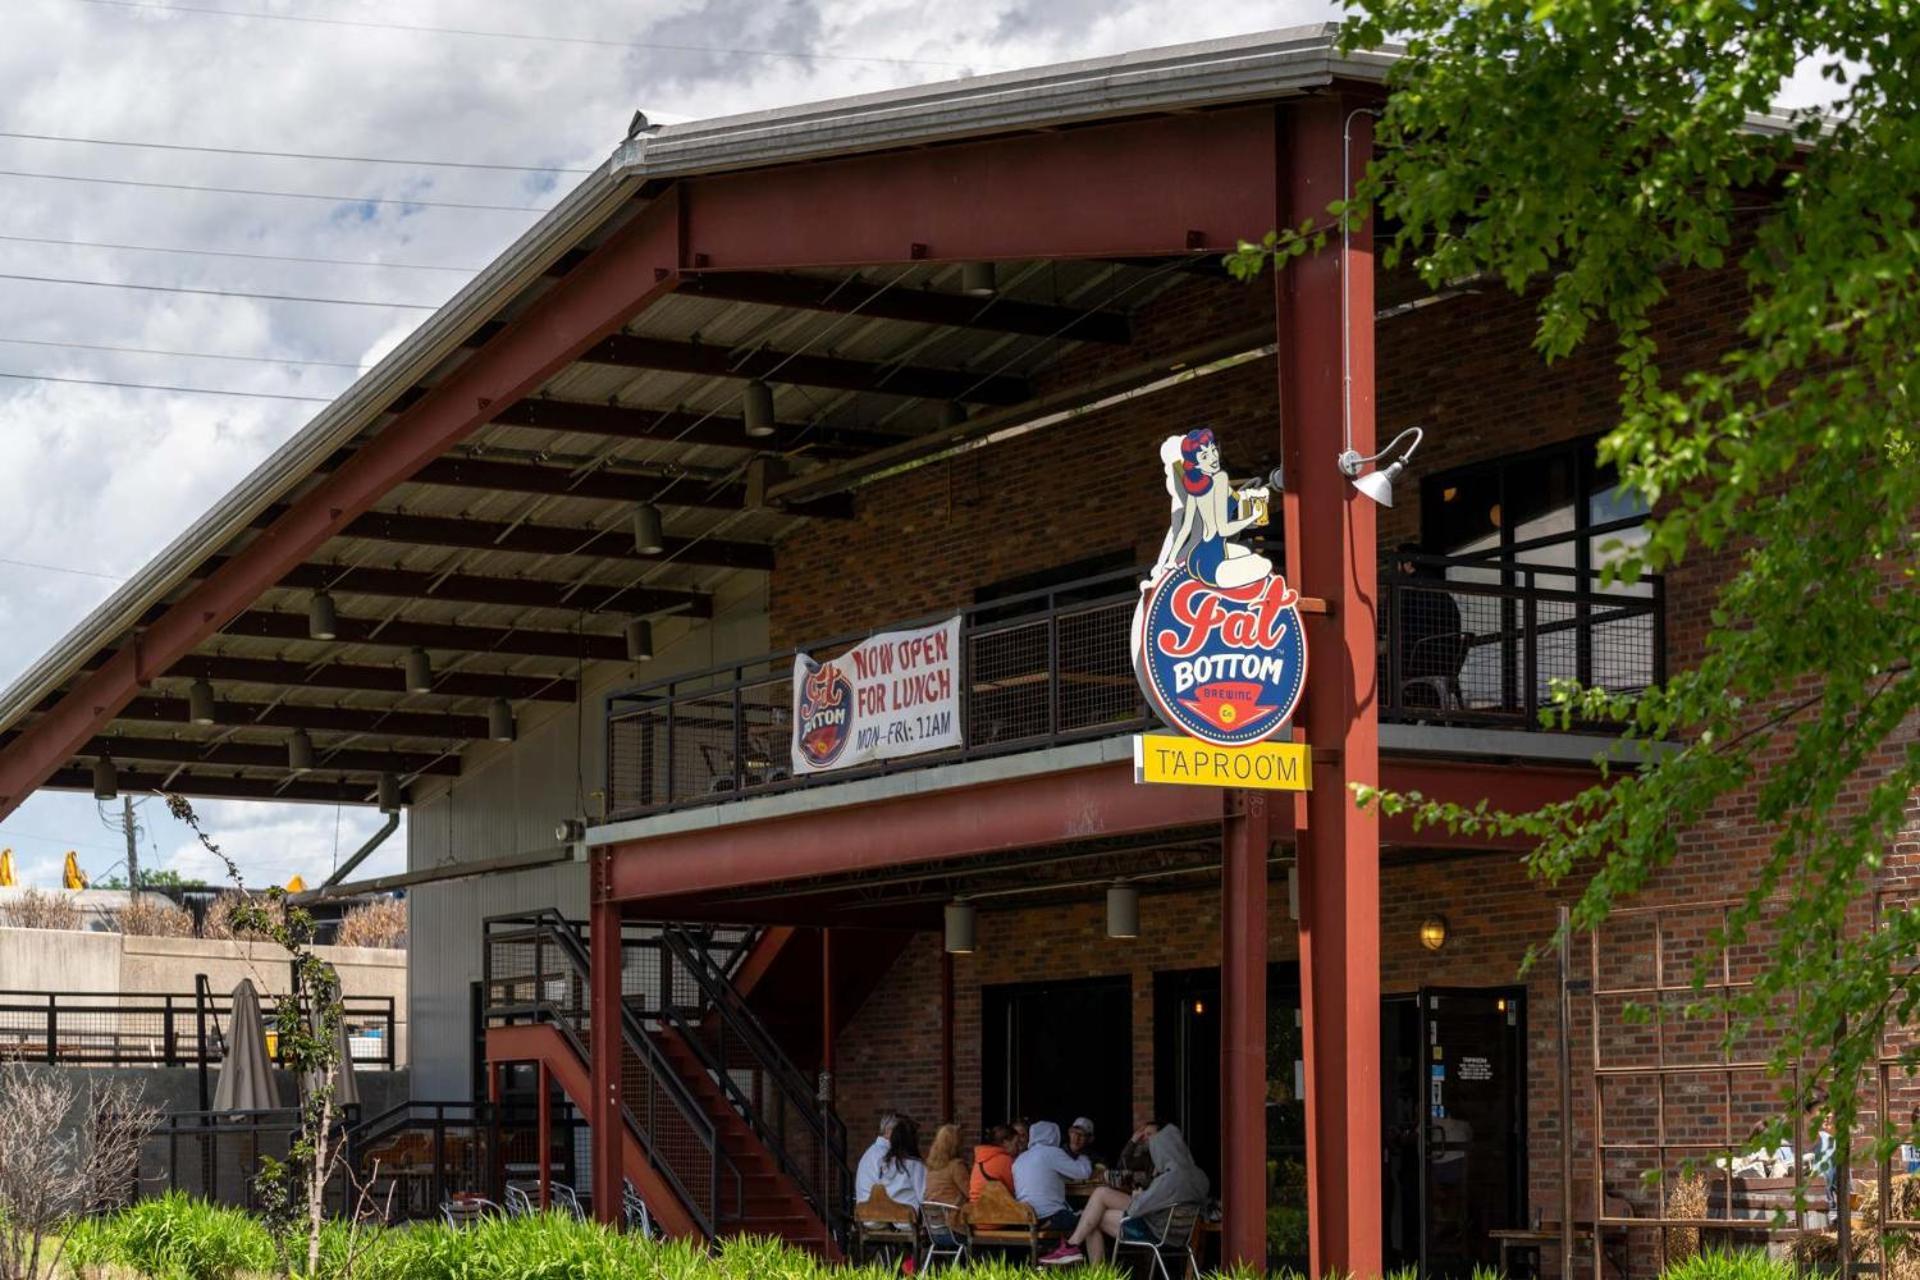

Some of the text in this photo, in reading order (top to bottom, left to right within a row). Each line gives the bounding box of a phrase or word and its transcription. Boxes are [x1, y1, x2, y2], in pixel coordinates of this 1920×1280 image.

[1158, 575, 1298, 658] Fat
[852, 629, 948, 680] NOW OPEN
[1173, 653, 1284, 694] BOTTOM
[858, 668, 950, 718] FOR LUNCH
[1204, 687, 1252, 700] BREWING
[918, 711, 951, 739] 11AM
[1156, 749, 1297, 781] TAPROOM
